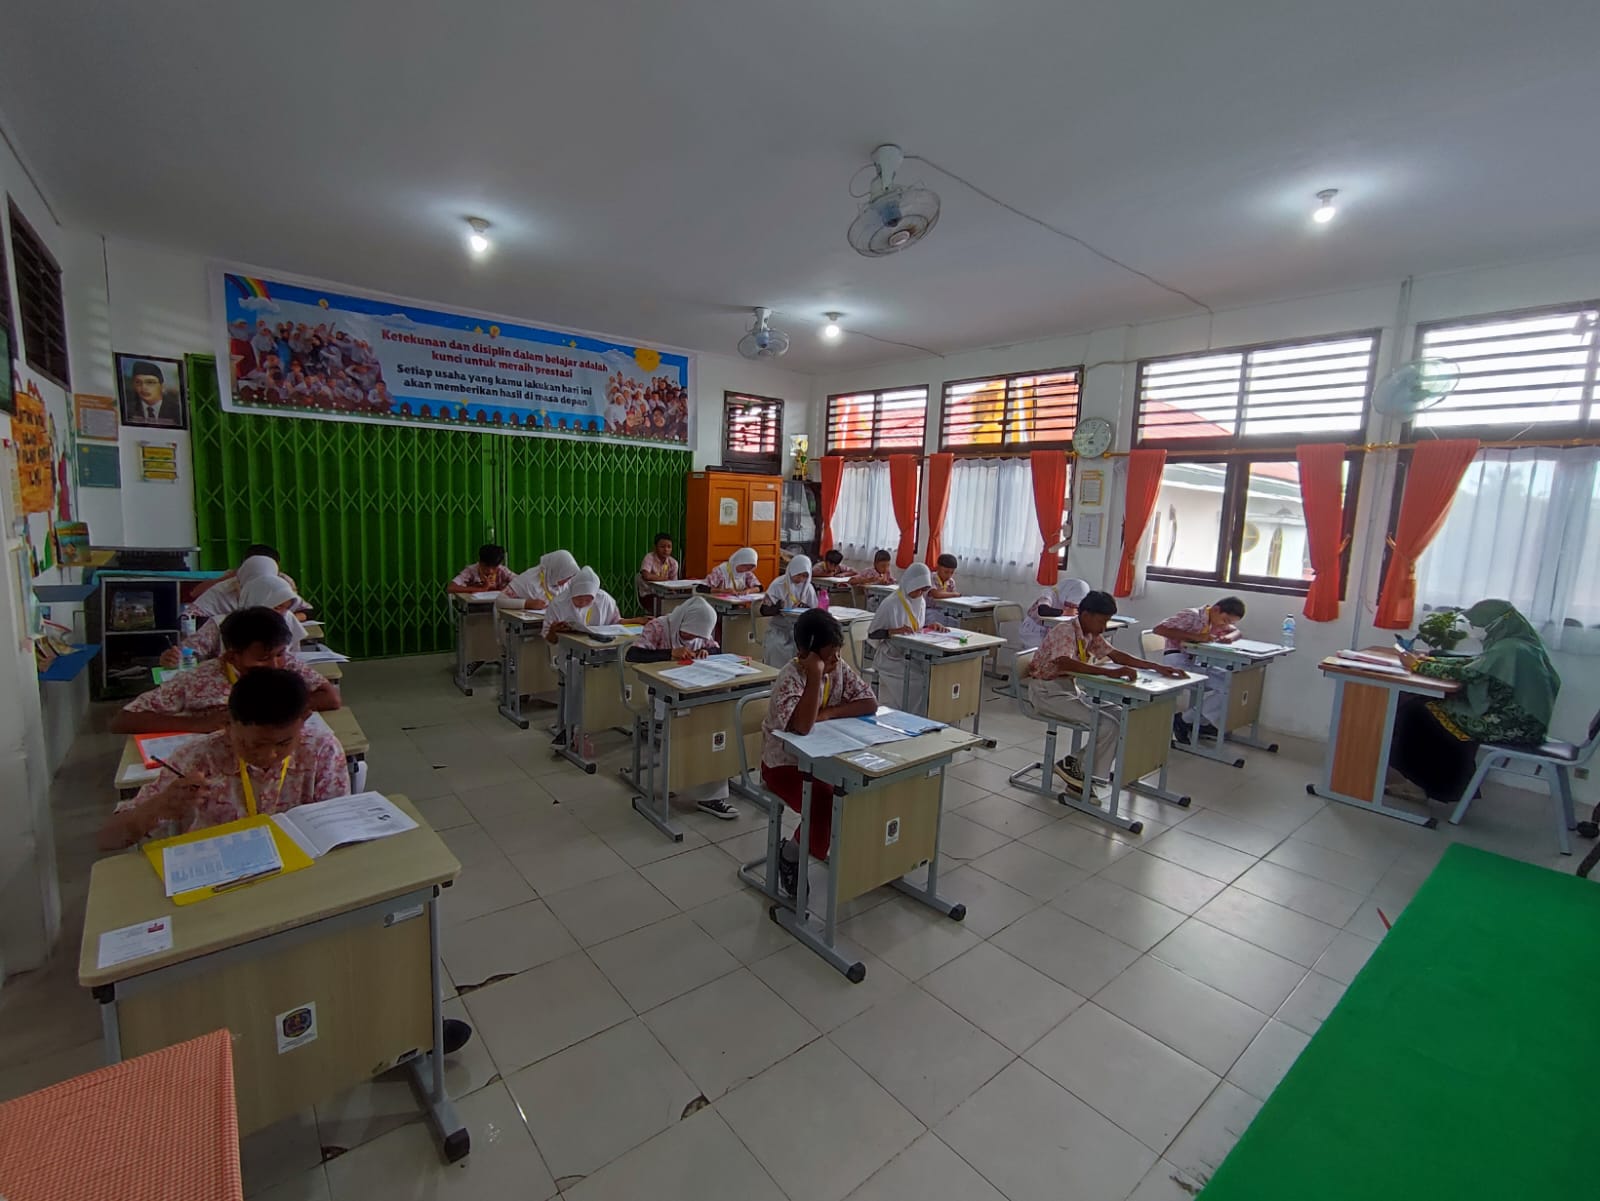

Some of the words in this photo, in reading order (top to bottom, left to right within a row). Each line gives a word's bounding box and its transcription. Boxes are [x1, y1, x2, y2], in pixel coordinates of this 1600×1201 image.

[381, 329, 446, 348] Ketekunan
[449, 340, 470, 351] dan
[472, 343, 511, 357] disiplin
[513, 349, 544, 362] dalam
[545, 354, 578, 367] belajar
[579, 360, 608, 372] adalah
[432, 351, 462, 363] kunci
[465, 357, 496, 368] untuk
[498, 361, 533, 373] meraih
[535, 366, 573, 378] prestasi
[397, 364, 432, 378] Setiap
[435, 370, 466, 381] usaha
[469, 375, 493, 386] yang
[496, 376, 522, 387] kamu
[525, 379, 560, 392] lakukan
[562, 384, 579, 395] hari
[581, 387, 592, 396] ini
[404, 378, 431, 389] akan
[434, 382, 498, 396] memberikan
[500, 389, 522, 399] hasil
[524, 391, 533, 400] di
[535, 394, 558, 403] masa
[560, 395, 588, 407] depan
